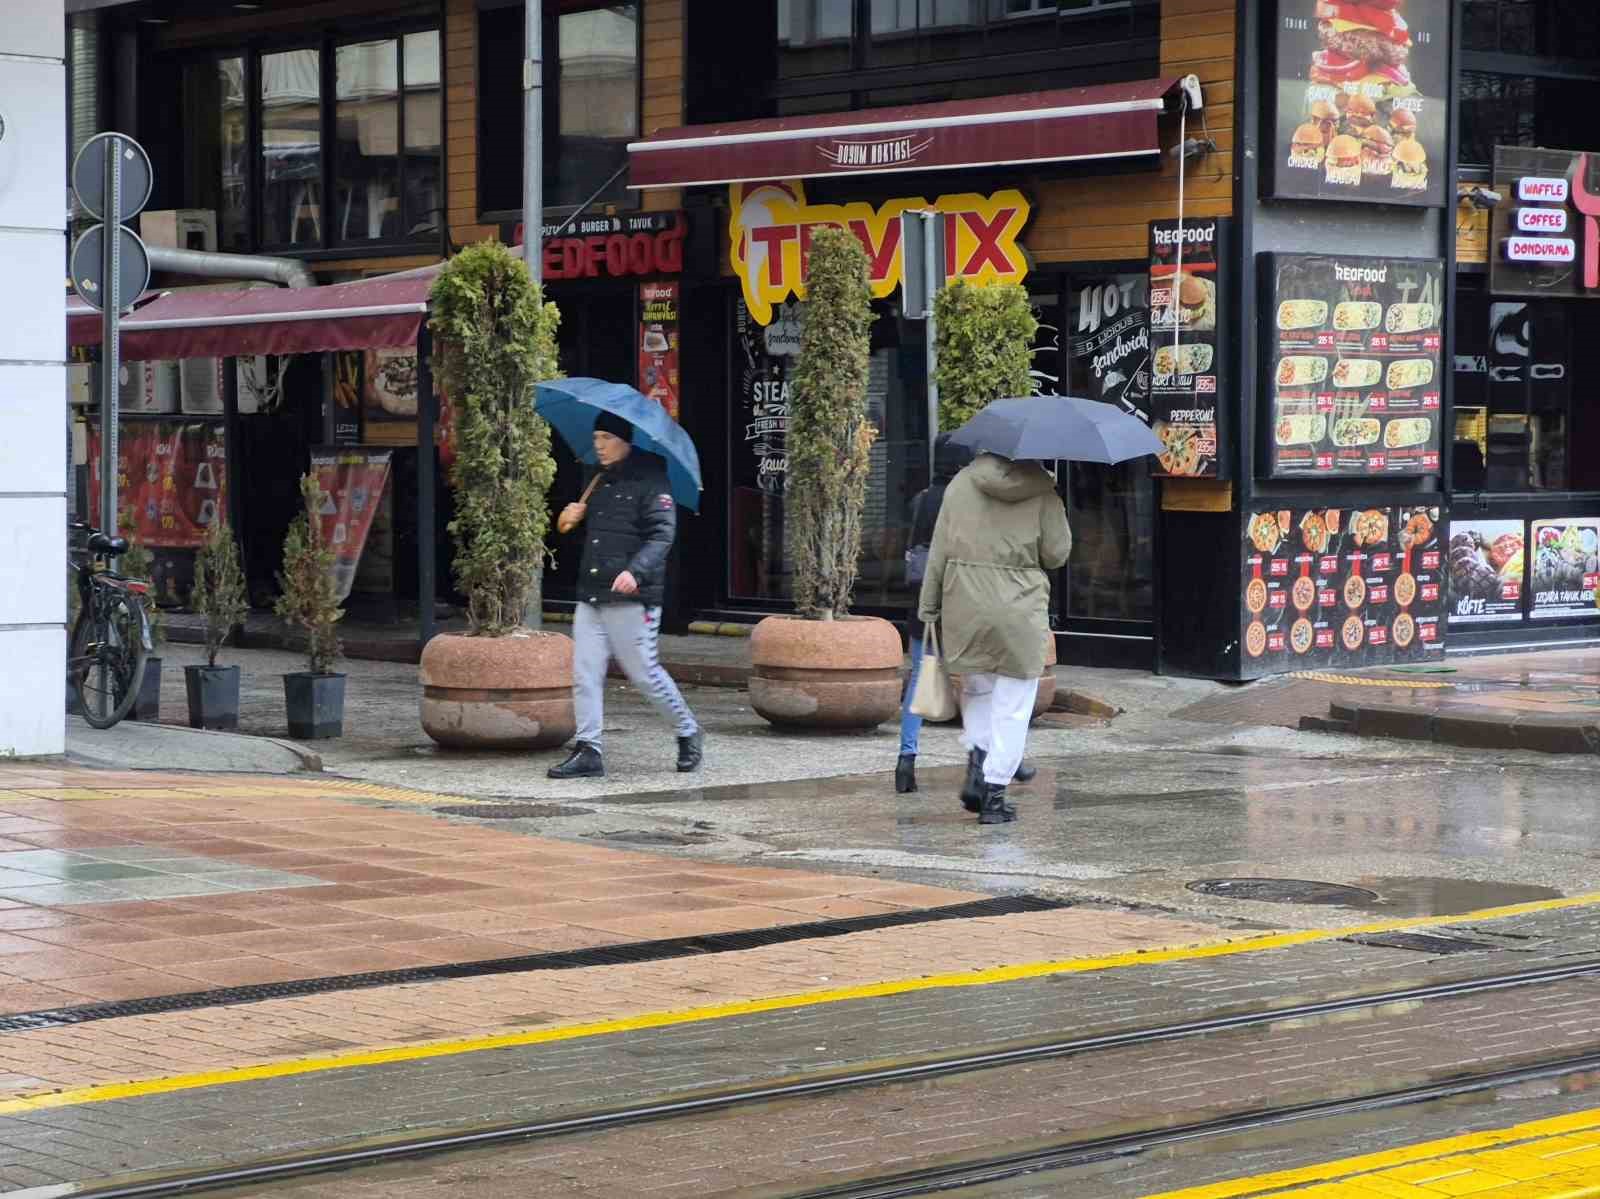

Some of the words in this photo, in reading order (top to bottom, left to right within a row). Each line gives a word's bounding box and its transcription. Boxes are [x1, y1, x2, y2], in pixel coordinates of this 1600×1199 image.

[1524, 183, 1563, 196] WAFFLE
[581, 219, 609, 233] BURGER
[629, 217, 652, 229] TAVUK
[1523, 214, 1562, 226] COFFEE
[1513, 243, 1570, 257] DONDURMA
[753, 382, 791, 401] STEA
[1457, 595, 1486, 615] KÖFTE
